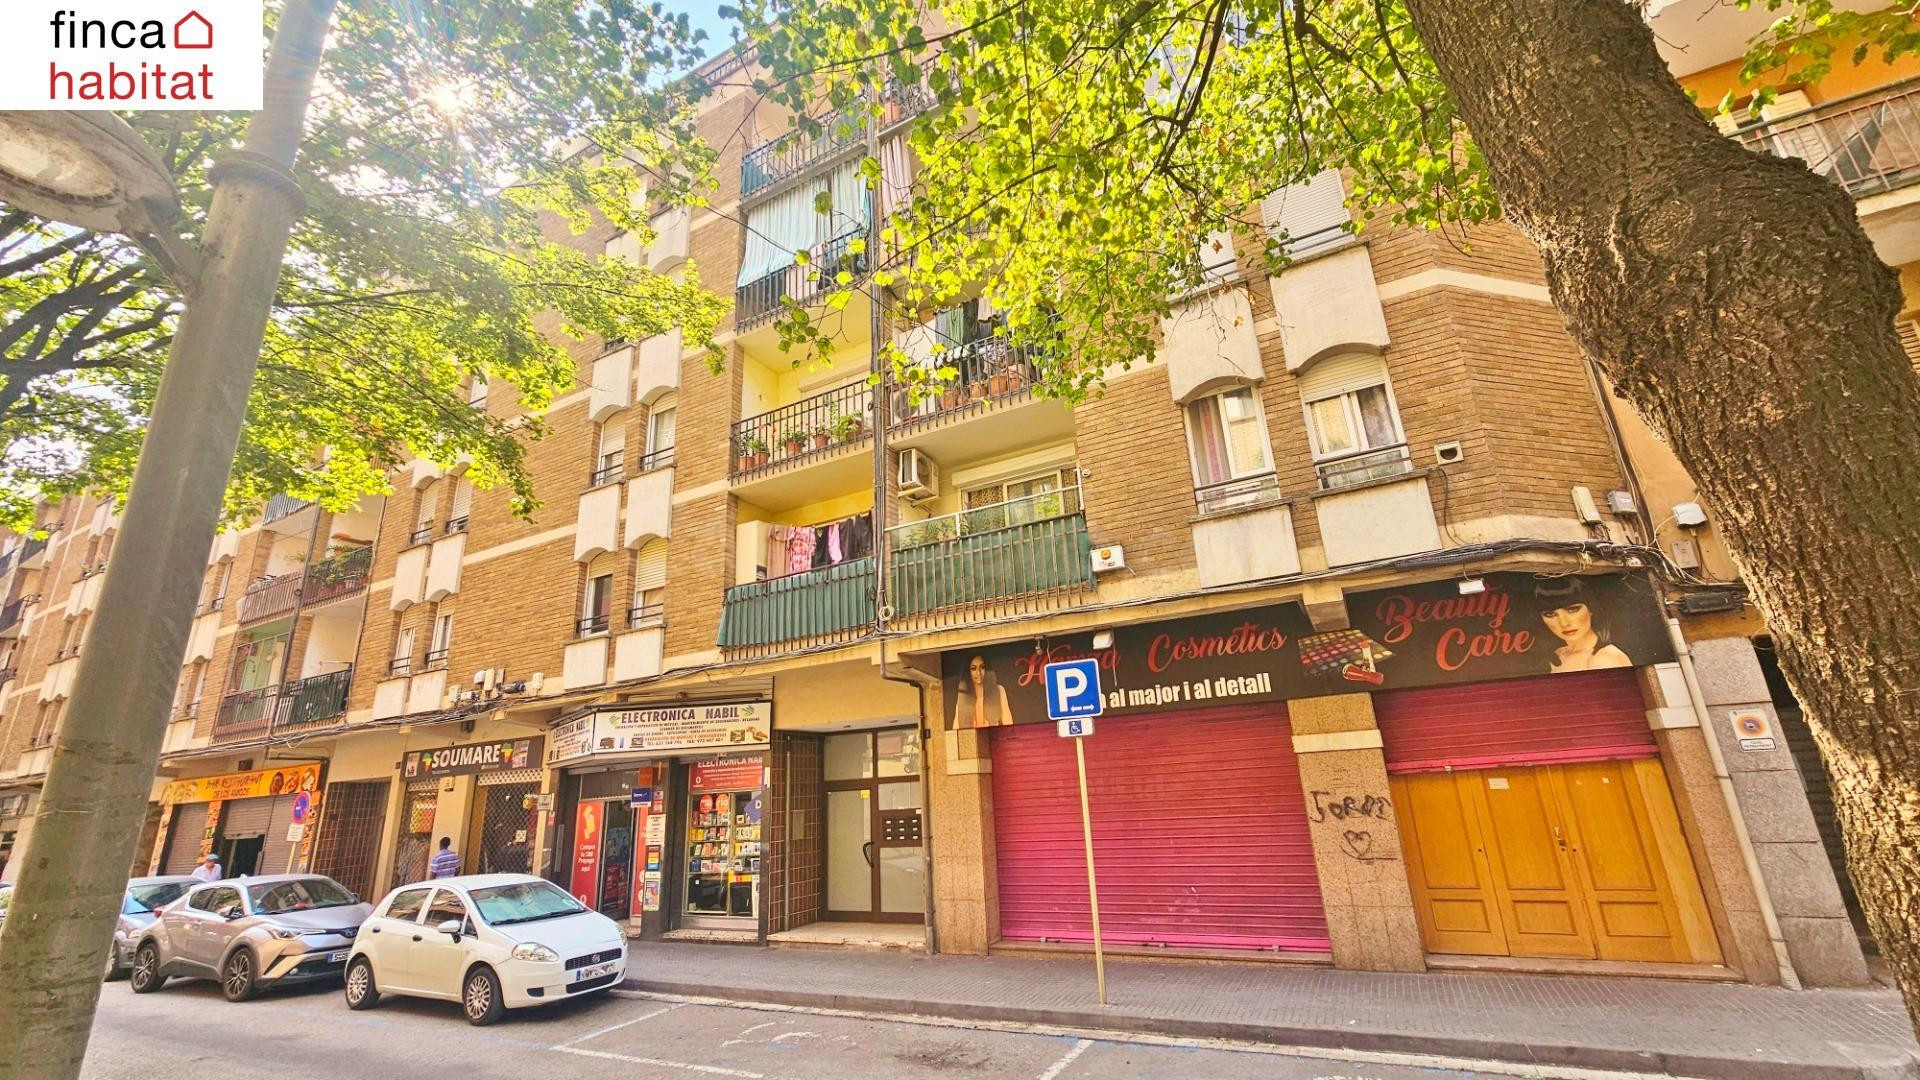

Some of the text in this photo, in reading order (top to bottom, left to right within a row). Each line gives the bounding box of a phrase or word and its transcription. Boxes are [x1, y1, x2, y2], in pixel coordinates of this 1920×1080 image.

[1375, 581, 1511, 644] Beauty
[1147, 621, 1288, 673] Cosmetics
[1436, 628, 1536, 671] Care
[1056, 667, 1088, 713] P
[1109, 688, 1126, 709] al
[1129, 683, 1181, 707] major
[1183, 681, 1191, 701] i
[1193, 678, 1212, 700] al
[1214, 672, 1272, 698] detall
[621, 707, 739, 724] ELECTRONICA NABIL
[431, 744, 501, 769] SOUMARE
